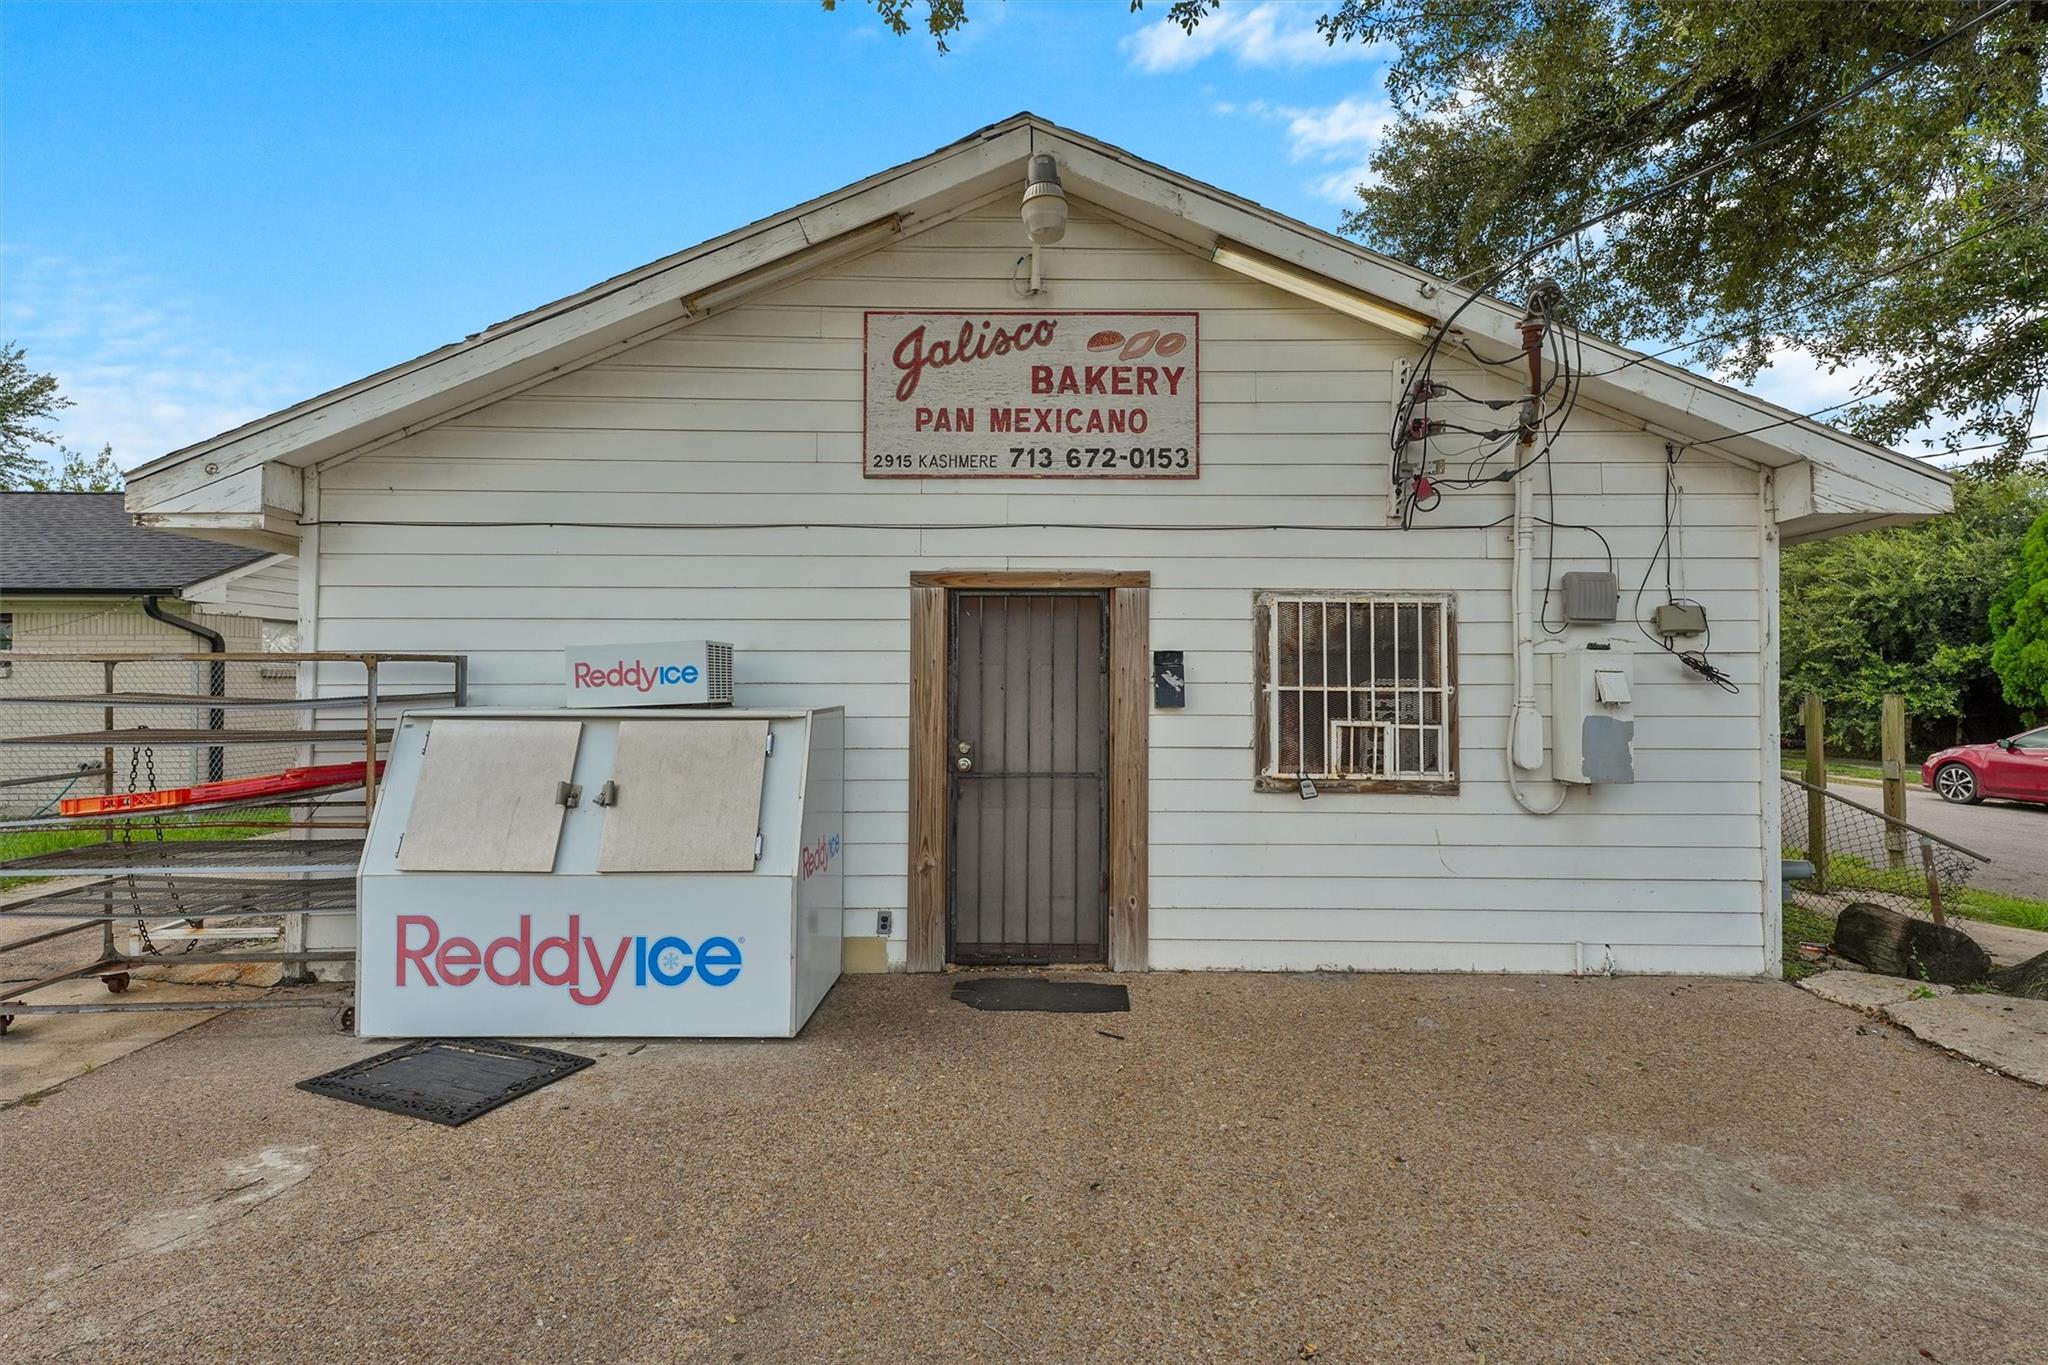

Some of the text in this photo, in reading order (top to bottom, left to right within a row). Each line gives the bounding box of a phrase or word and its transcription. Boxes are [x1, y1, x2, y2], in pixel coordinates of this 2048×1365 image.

[893, 319, 1058, 401] Jalisco
[1031, 365, 1186, 396] BAKERY
[915, 407, 1149, 434] PAN MEXICANO
[872, 447, 1190, 469] 2915 KASHMERE 713 672-0153
